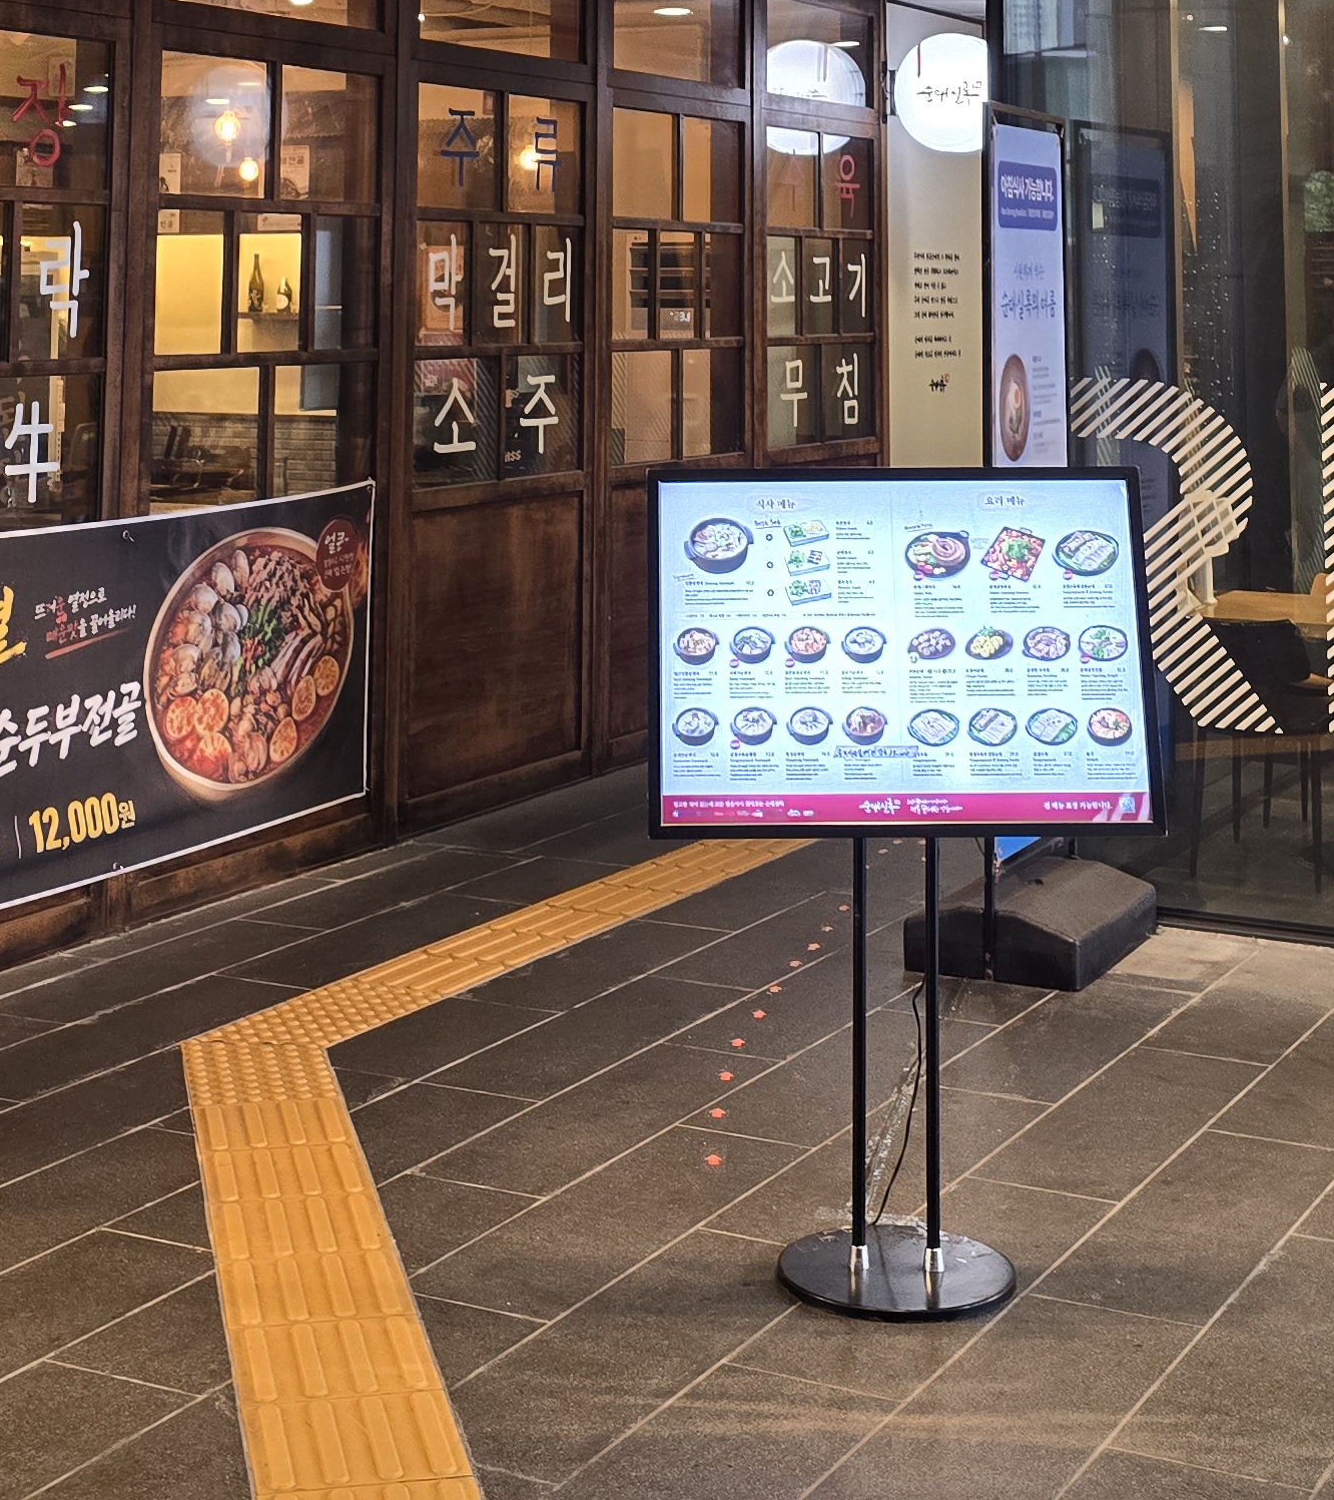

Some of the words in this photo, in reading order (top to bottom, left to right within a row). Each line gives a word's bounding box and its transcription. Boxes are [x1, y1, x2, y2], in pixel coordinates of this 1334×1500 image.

[916, 81, 981, 105] 순대실록
[440, 107, 561, 193] 주류
[428, 233, 572, 331] 막걸리
[770, 251, 866, 318] 소고기
[433, 373, 559, 455] 소주
[779, 352, 859, 428] 무침
[1006, 495, 1026, 507] 메뉴
[324, 531, 351, 555] 얼큰
[27, 790, 136, 855] 12,000원
